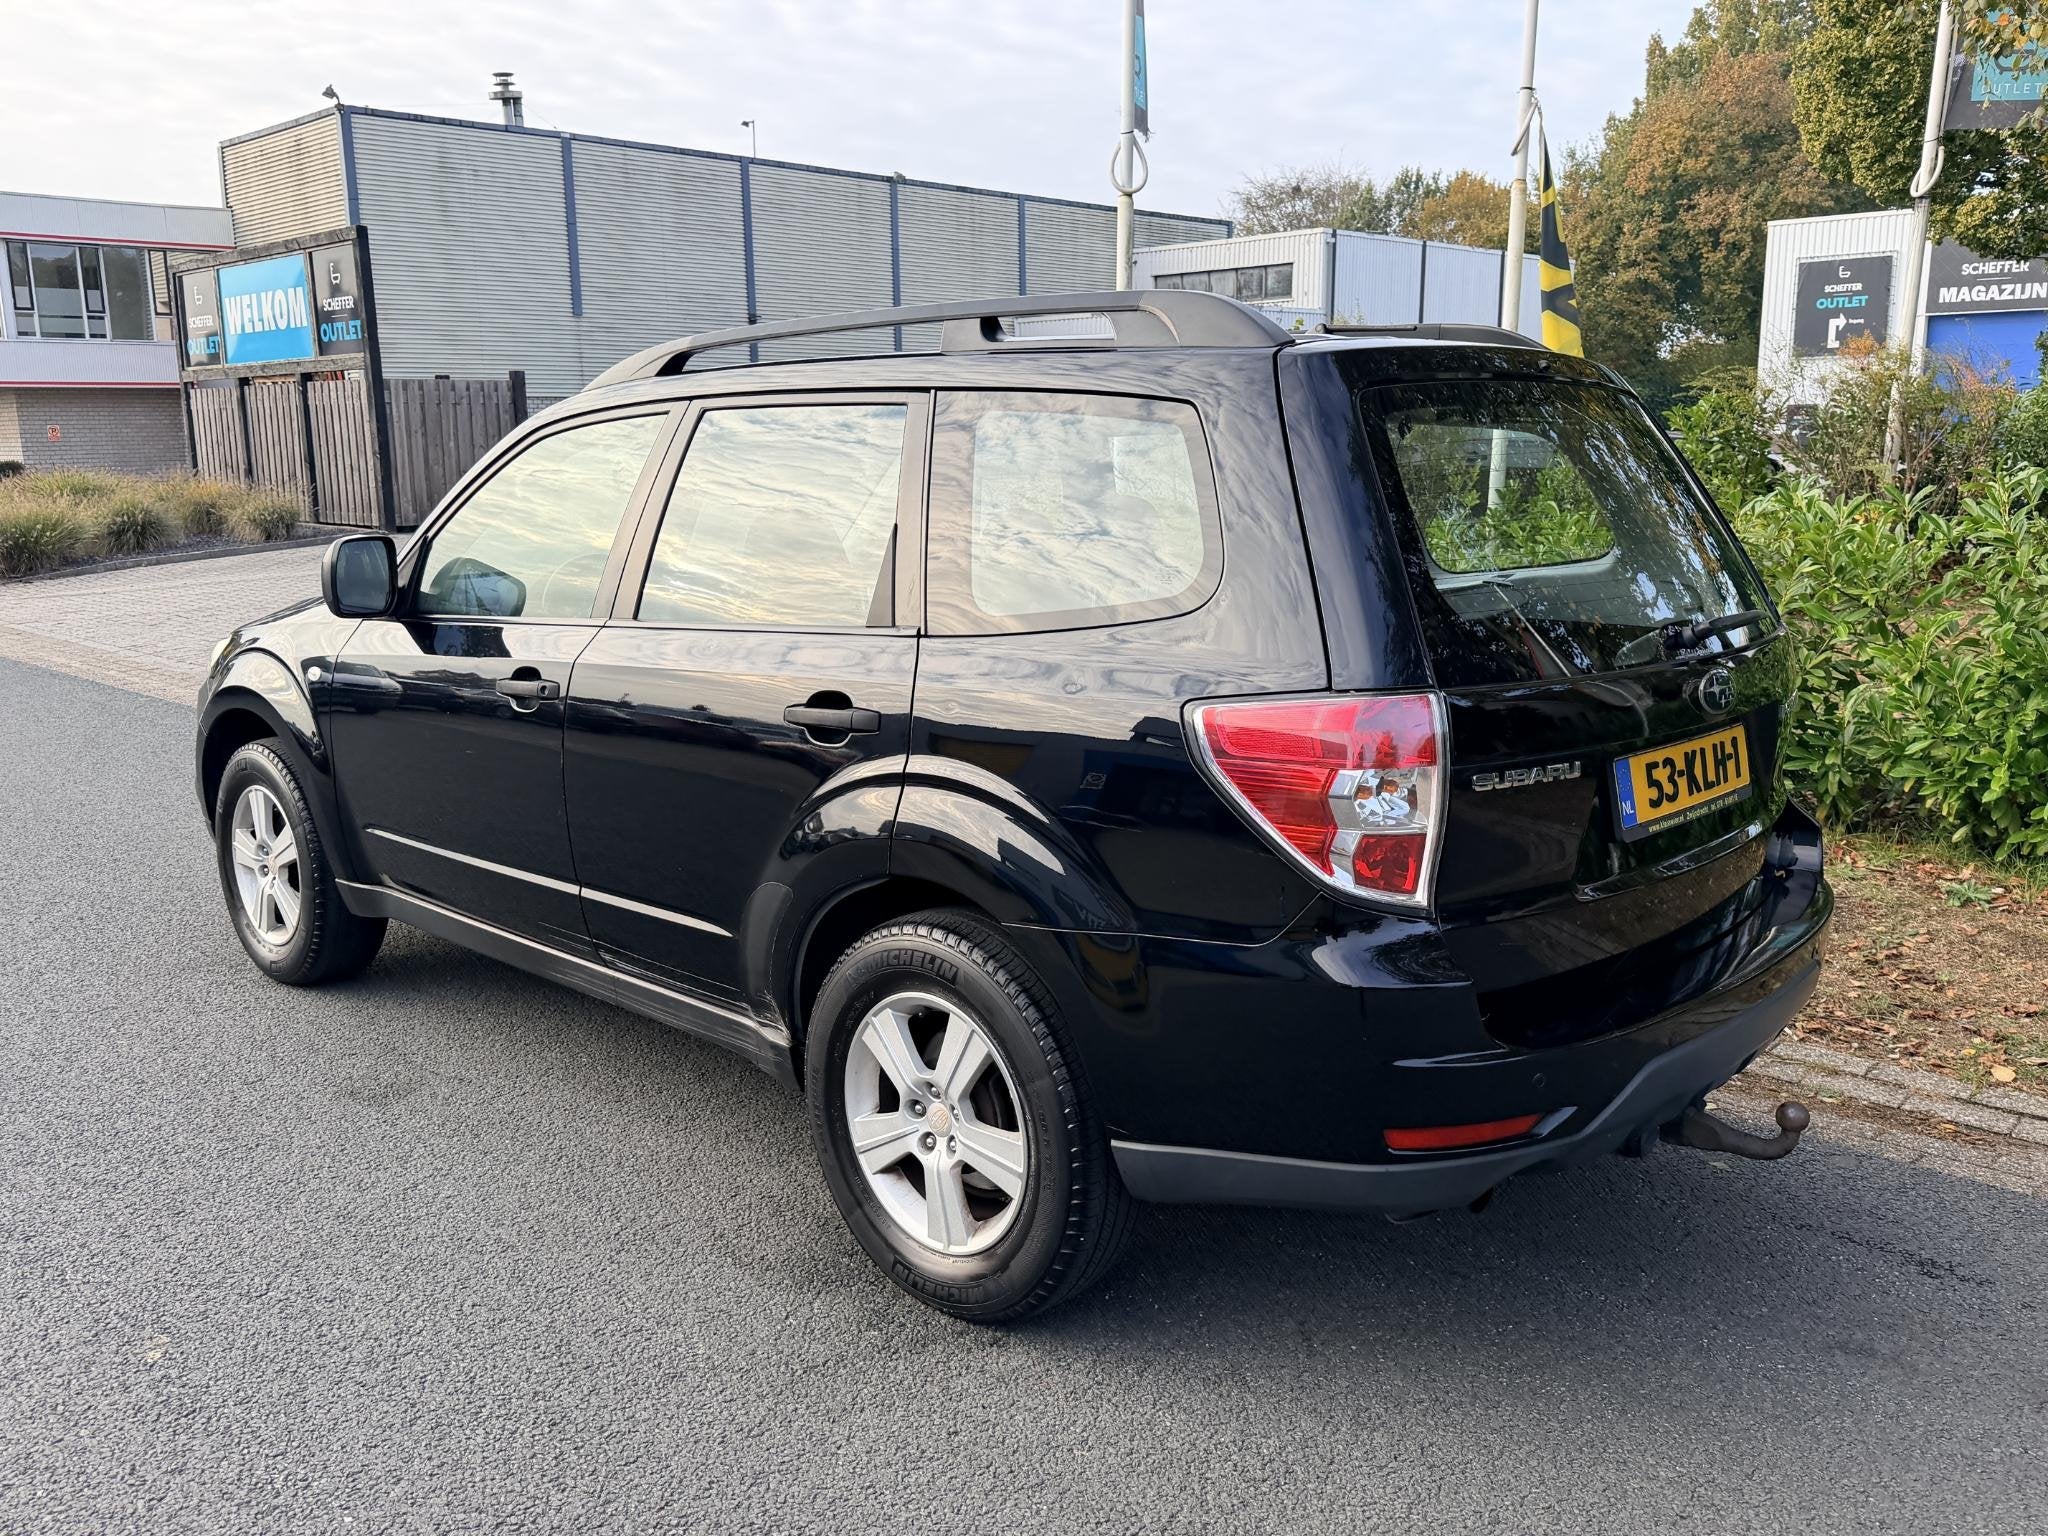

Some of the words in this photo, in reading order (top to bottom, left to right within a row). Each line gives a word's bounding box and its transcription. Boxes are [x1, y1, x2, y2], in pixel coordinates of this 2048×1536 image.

[1961, 260, 2030, 276] SCHEFFER
[1824, 282, 1863, 293] SCHEFFER
[1938, 282, 2048, 303] MAGAZIJN
[224, 286, 308, 335] WELKOM
[322, 295, 354, 312] SCHEFFER
[1816, 295, 1868, 309] OUTLET
[188, 315, 213, 329] SCHEFFER
[320, 319, 361, 343] OUTLET
[187, 336, 220, 355] OUTLET
[1472, 760, 1582, 792] SUBARU
[1645, 736, 1742, 809] 53-KLH-1
[1621, 800, 1635, 816] NL
[867, 949, 958, 981] MICHELIN
